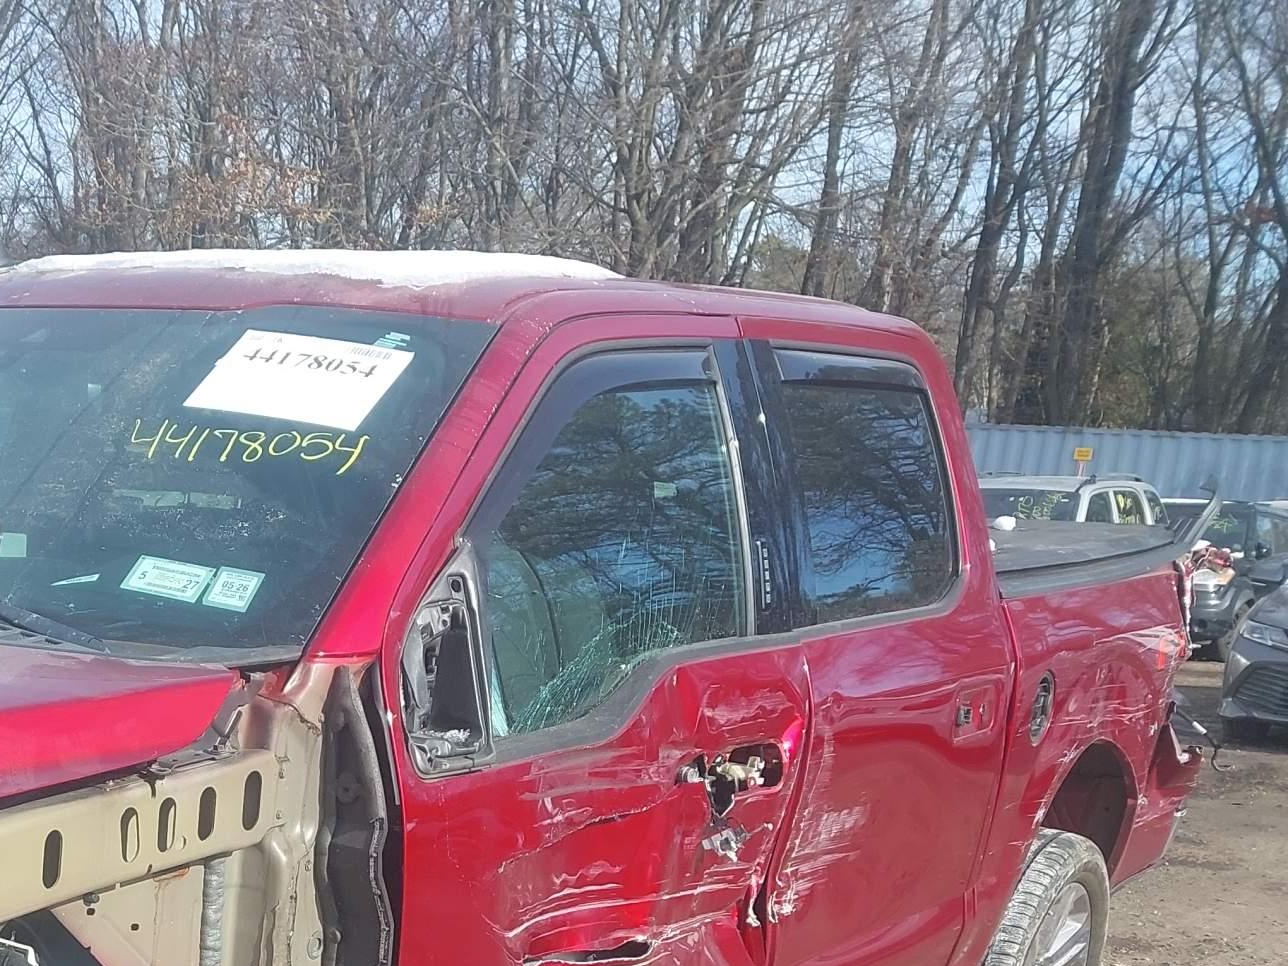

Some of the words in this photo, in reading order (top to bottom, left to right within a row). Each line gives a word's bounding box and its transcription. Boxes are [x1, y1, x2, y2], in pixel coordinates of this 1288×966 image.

[243, 347, 378, 377] 44178054
[130, 418, 370, 475] 44178054
[138, 571, 149, 580] 5
[182, 579, 200, 590] 27
